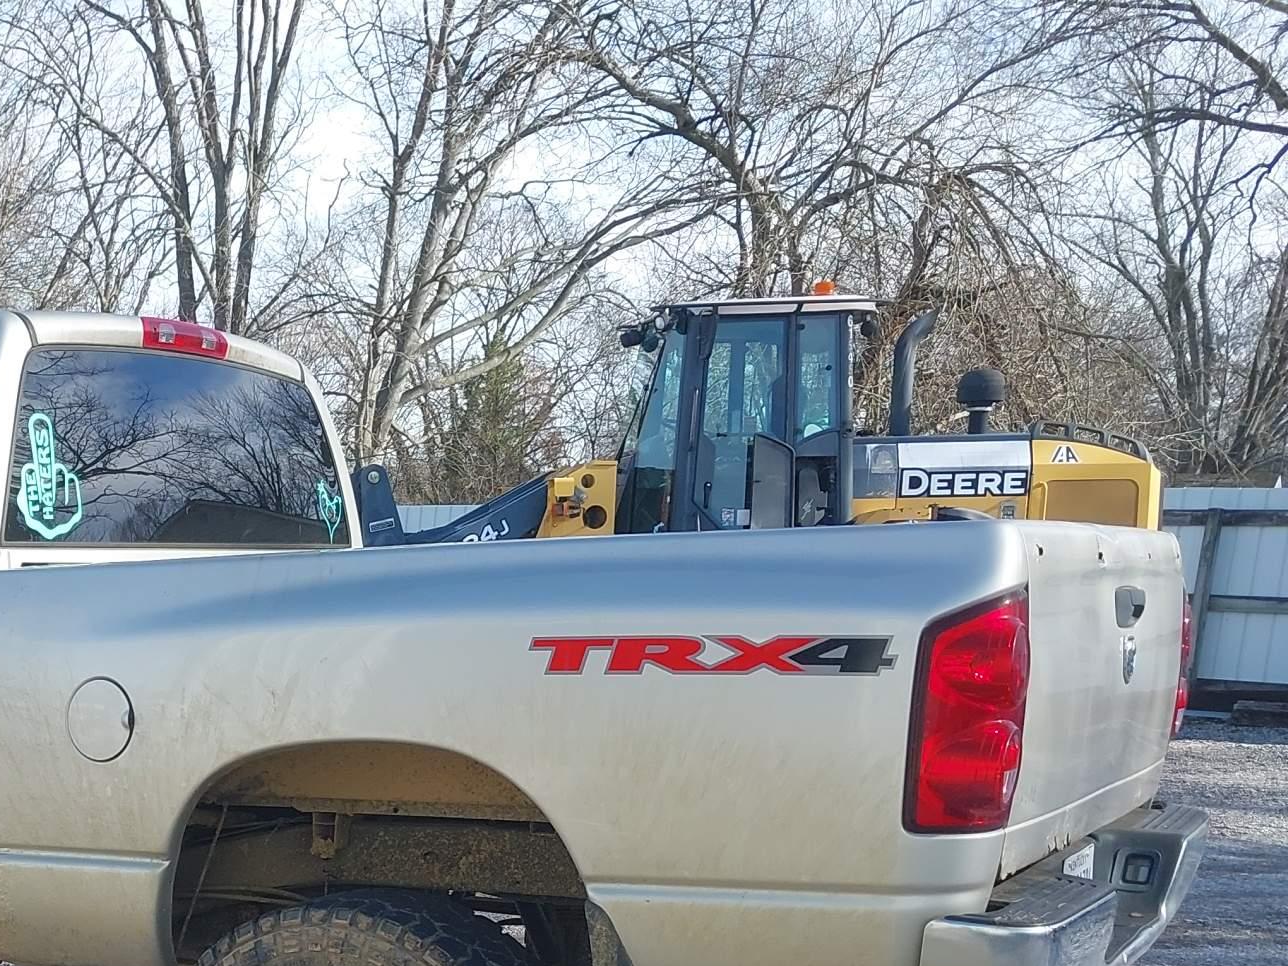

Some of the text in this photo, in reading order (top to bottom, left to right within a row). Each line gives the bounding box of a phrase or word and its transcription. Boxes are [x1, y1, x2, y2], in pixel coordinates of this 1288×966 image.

[25, 471, 40, 518] THE
[36, 429, 54, 520] HATERS
[901, 468, 1027, 496] DEERE
[528, 634, 898, 676] TRX4
